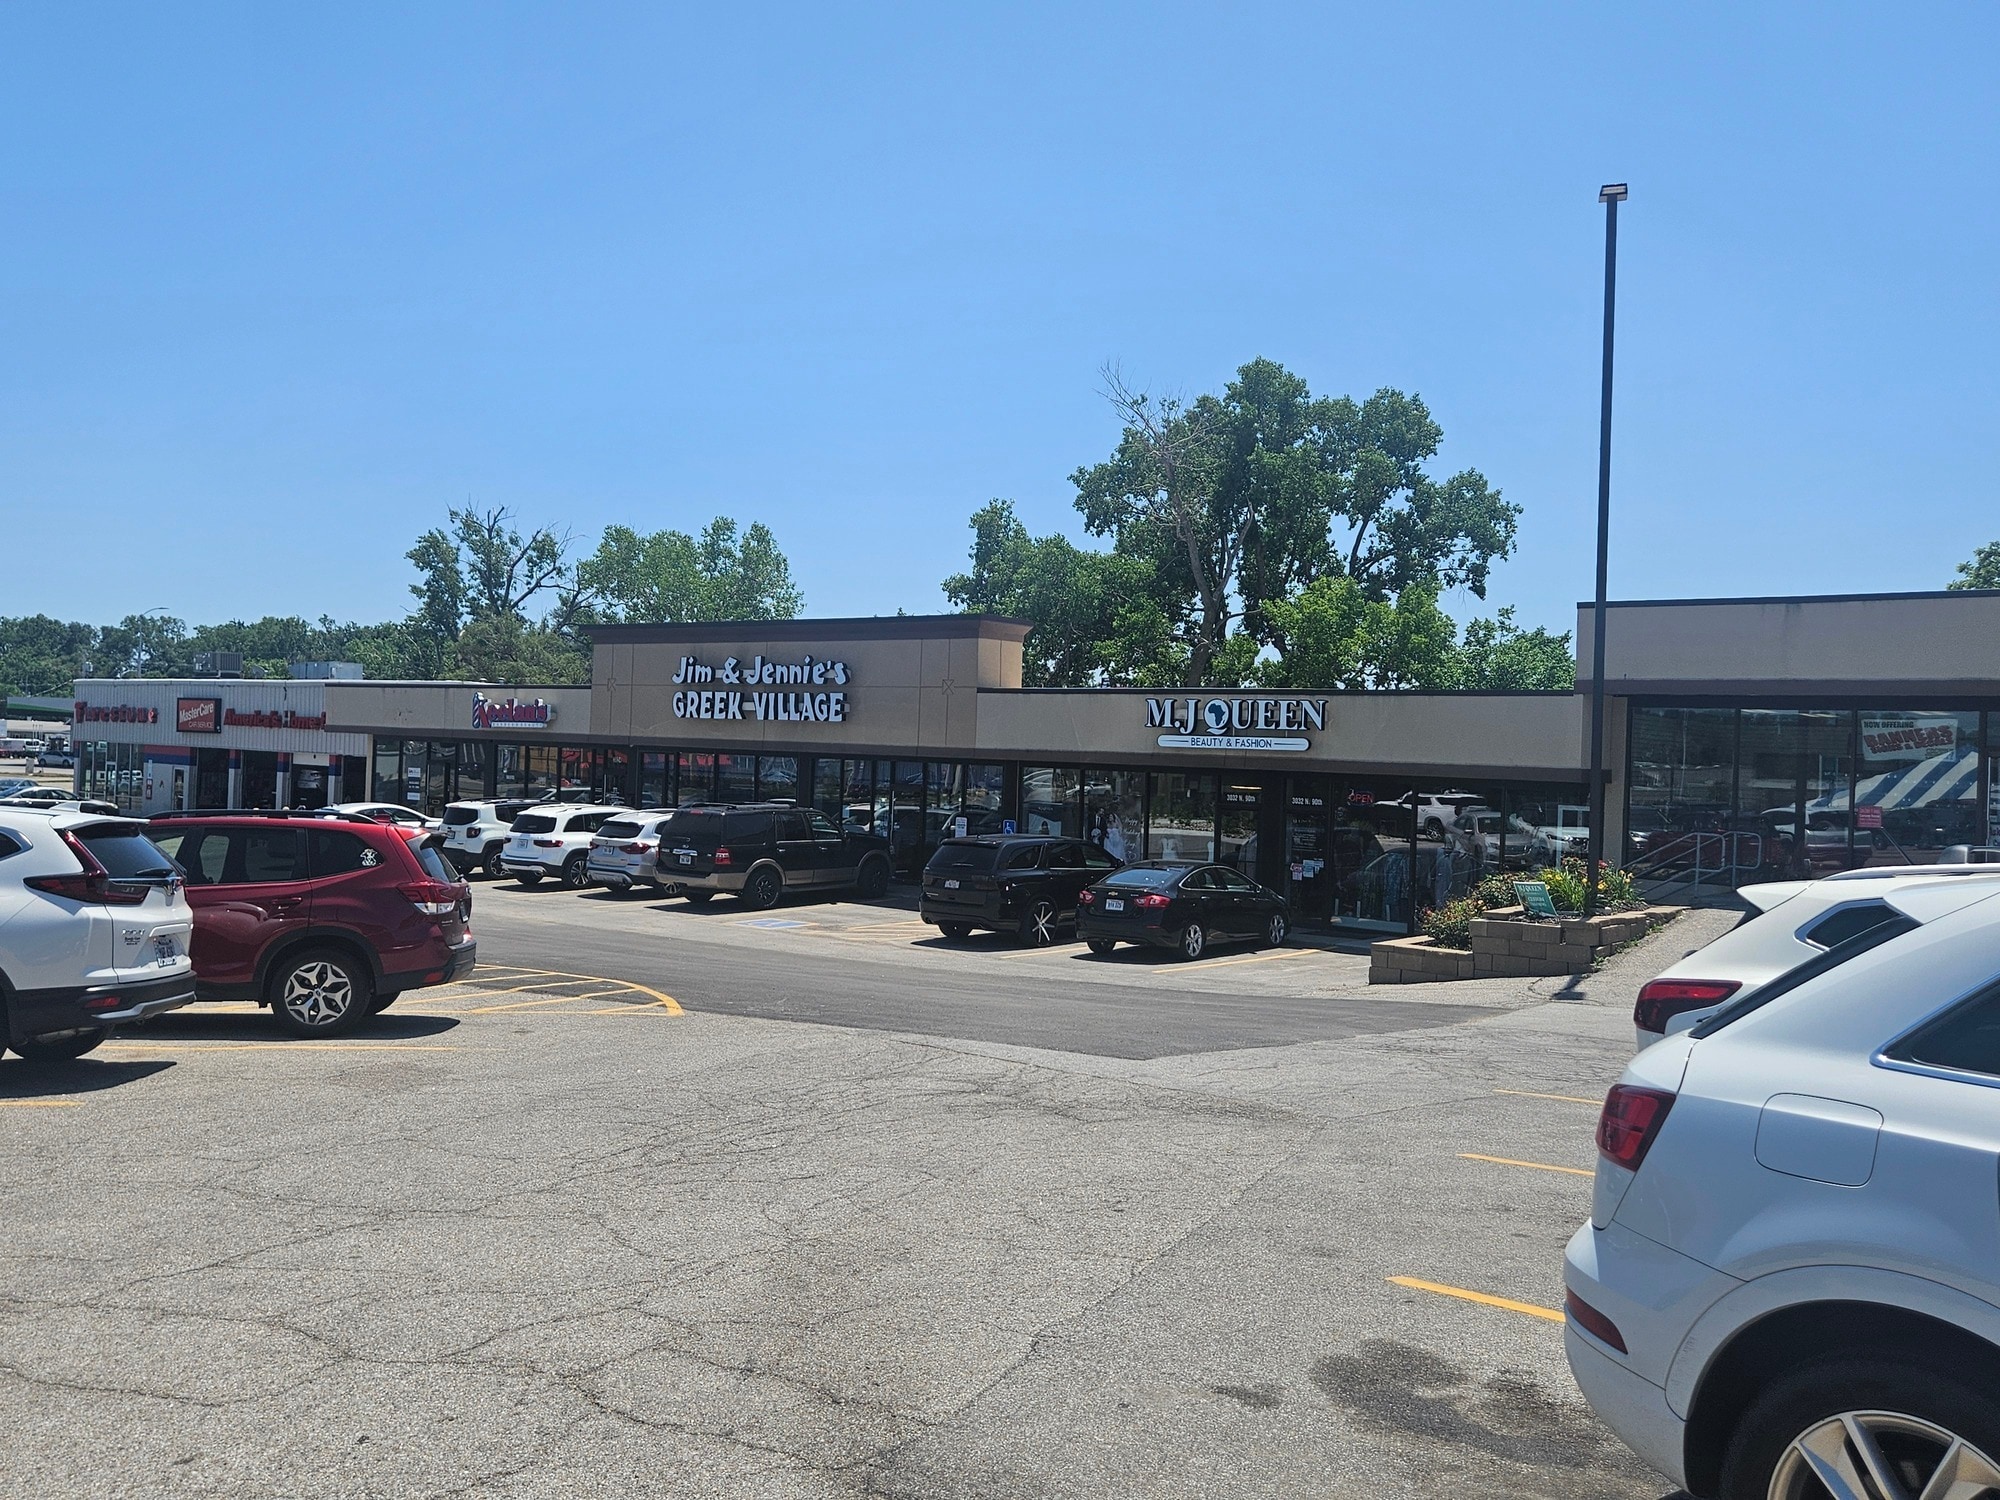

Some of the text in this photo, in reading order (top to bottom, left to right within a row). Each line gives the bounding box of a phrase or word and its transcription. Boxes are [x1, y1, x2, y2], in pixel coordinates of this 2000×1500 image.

[671, 655, 847, 685] Jim & Jennie's
[179, 702, 214, 723] MasterCare
[672, 691, 845, 721] GREEK VILLAGE
[1203, 698, 1327, 735] QUEEN
[1863, 721, 1914, 729] NOW OFFERING
[1190, 737, 1272, 749] BEAUTY & FASHION
[1863, 725, 1953, 748] BANNERS
[1350, 794, 1374, 805] OPEN
